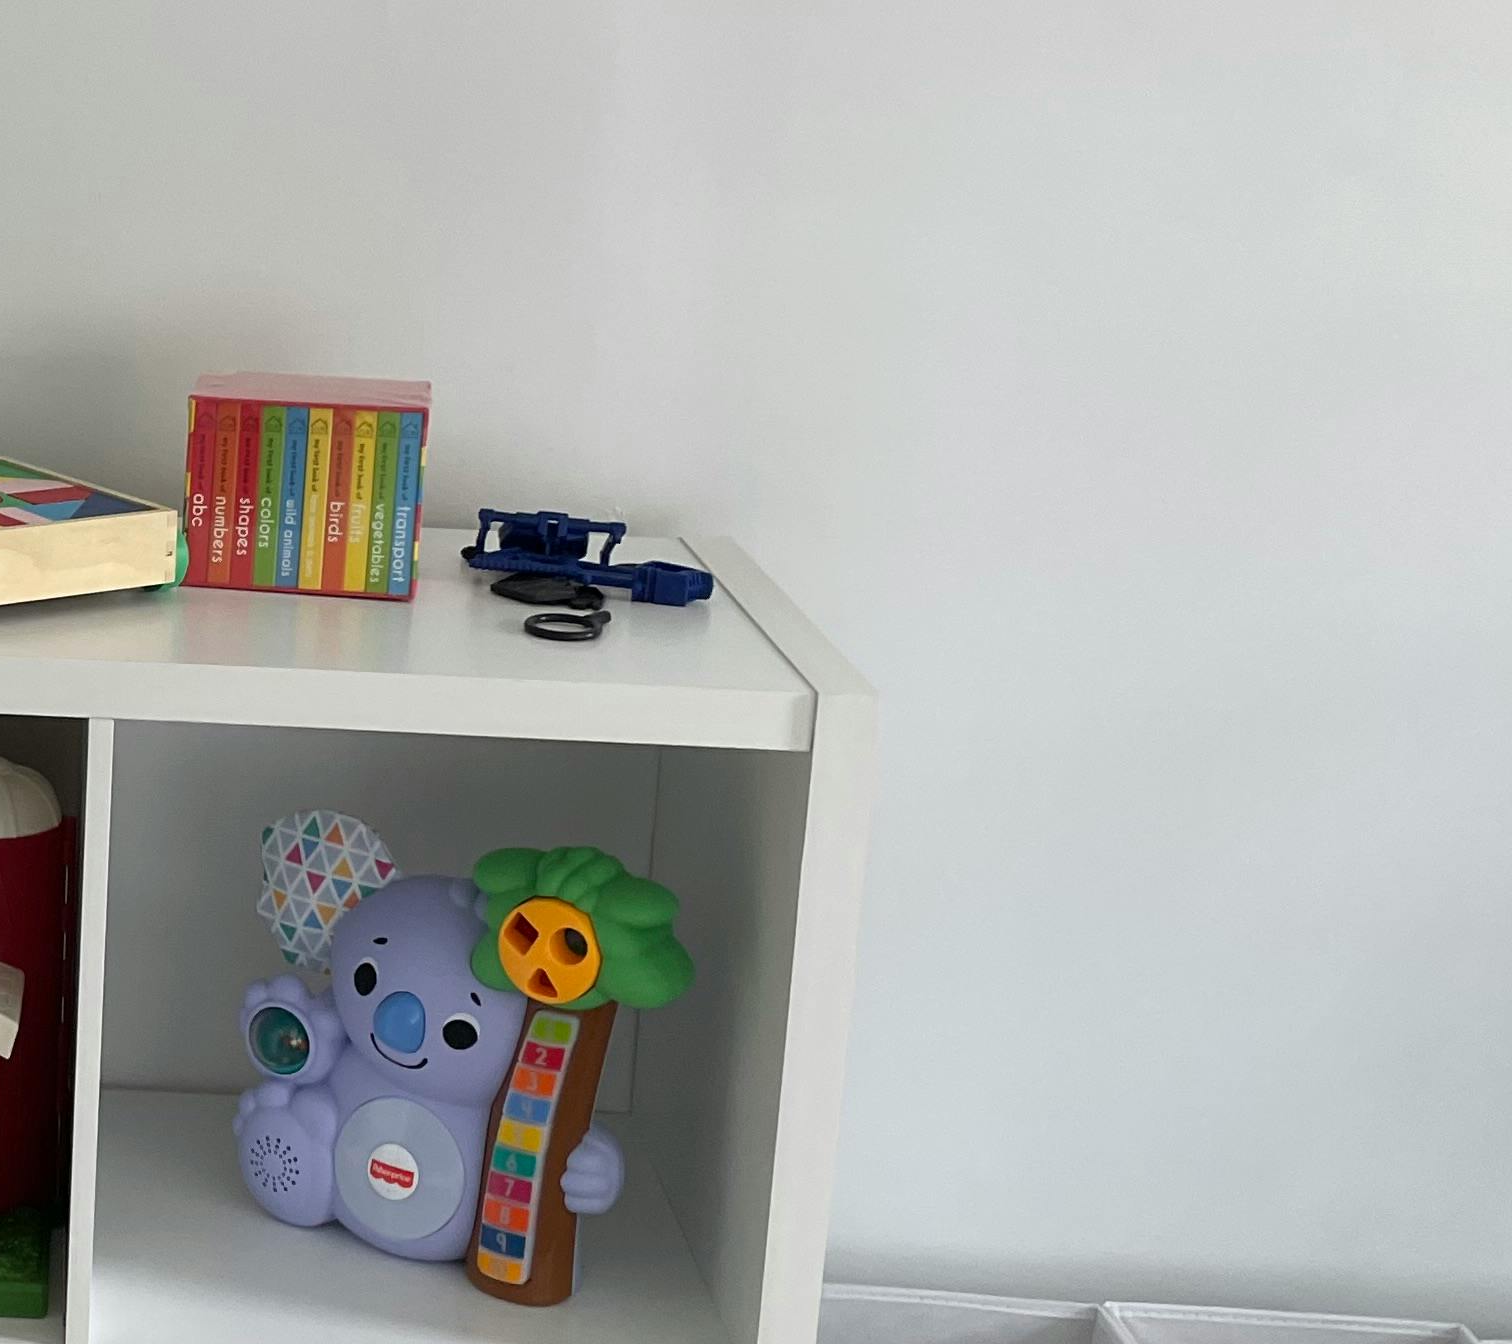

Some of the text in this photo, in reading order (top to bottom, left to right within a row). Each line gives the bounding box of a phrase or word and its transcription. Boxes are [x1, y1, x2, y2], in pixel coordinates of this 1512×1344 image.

[191, 493, 208, 527] abc
[211, 496, 228, 563] numbers
[235, 497, 254, 556] shapes
[258, 497, 275, 548] colors
[284, 499, 297, 525] wild
[328, 501, 346, 543] birds
[349, 502, 367, 544] fruits
[281, 529, 294, 577] animals
[369, 503, 386, 583] vegetables
[391, 506, 412, 583] transport
[535, 1047, 549, 1067] 2
[505, 1153, 518, 1168] 6
[503, 1178, 515, 1197] 7
[499, 1206, 512, 1226] 8
[495, 1232, 508, 1251] 9
